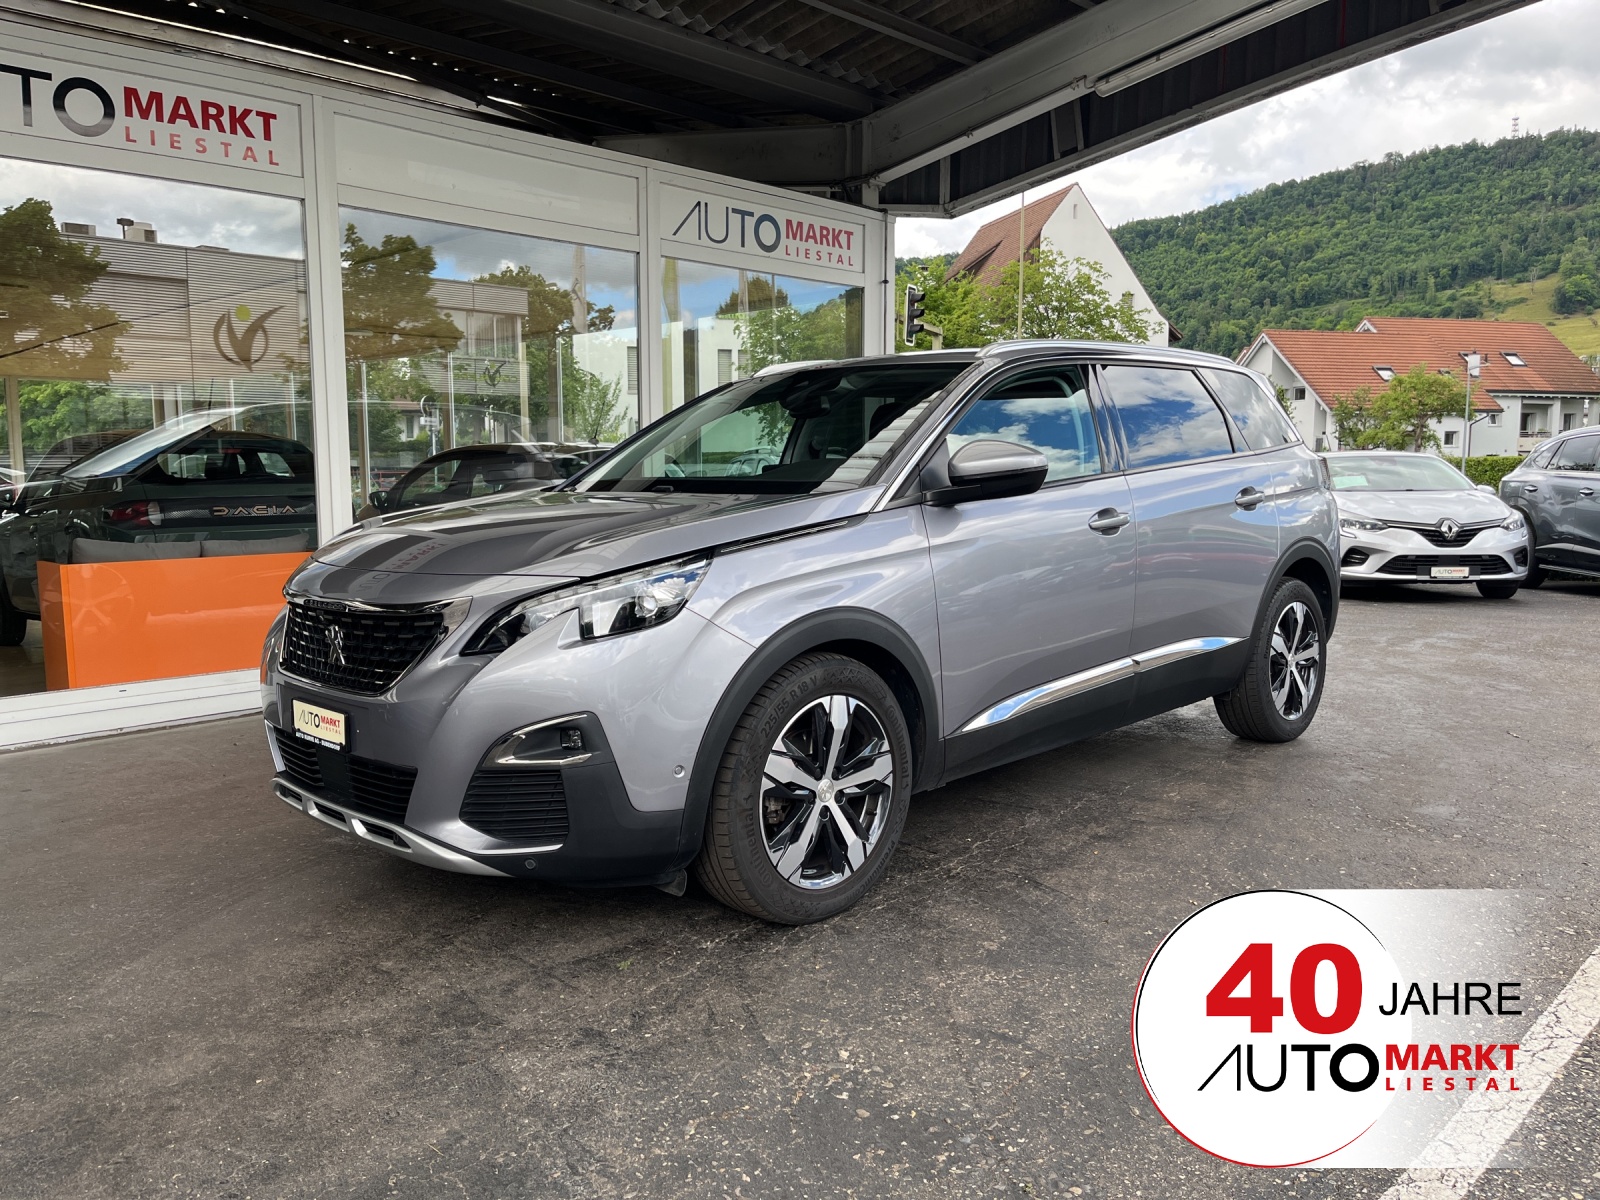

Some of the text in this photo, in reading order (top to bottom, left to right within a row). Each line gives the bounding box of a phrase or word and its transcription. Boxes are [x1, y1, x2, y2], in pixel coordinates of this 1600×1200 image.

[123, 86, 277, 142] MARKT
[125, 125, 279, 166] LIESTAL
[672, 200, 854, 253] AUTO MARKT
[785, 245, 854, 266] LIESTAL
[212, 505, 296, 516] DACIA
[299, 709, 341, 729] AUTO MARKT
[761, 697, 790, 738] 225/55
